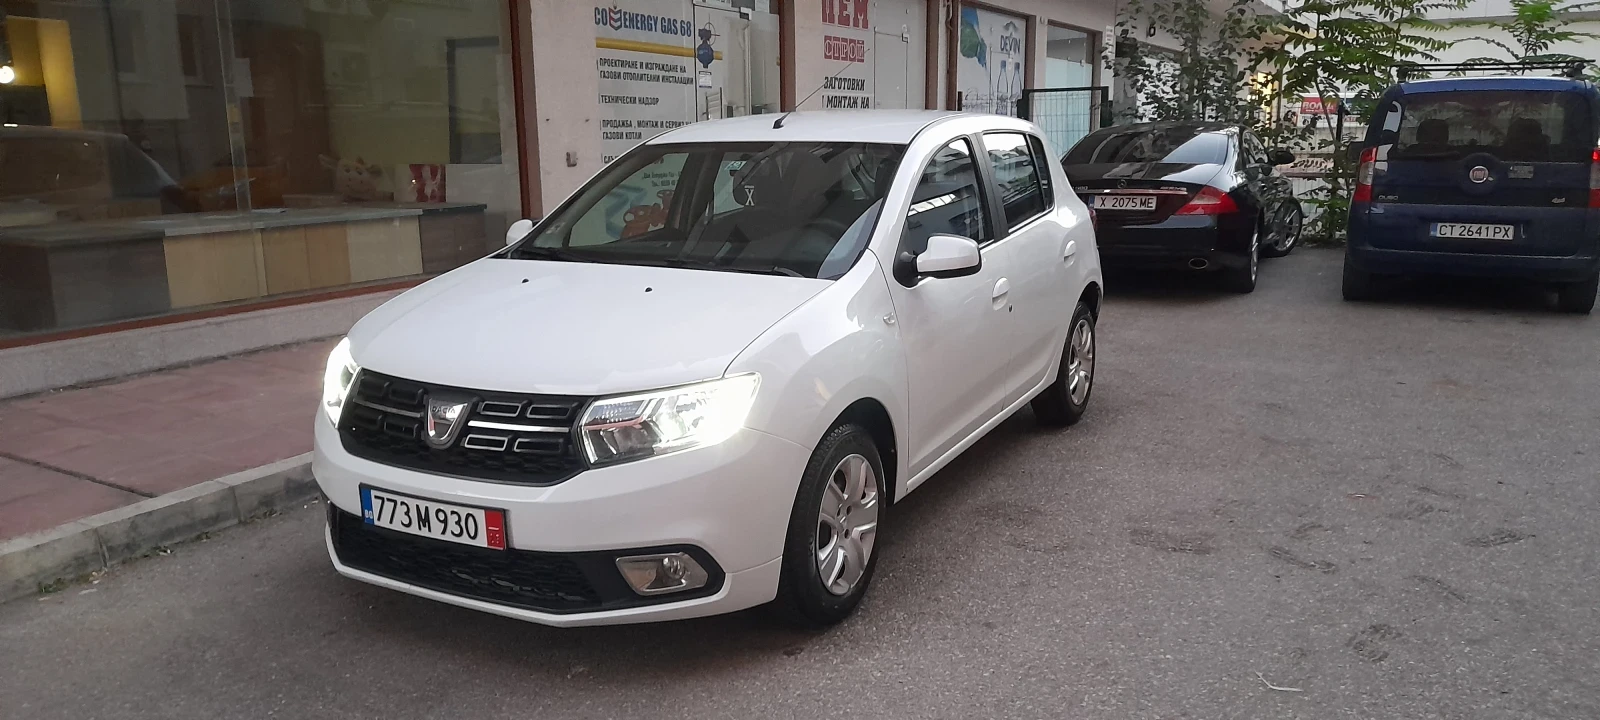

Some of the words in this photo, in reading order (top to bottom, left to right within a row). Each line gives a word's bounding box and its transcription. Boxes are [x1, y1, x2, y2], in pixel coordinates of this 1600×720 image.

[660, 16, 678, 36] GAS
[680, 19, 692, 37] 68
[824, 38, 865, 61] СТРОЙ
[1000, 33, 1021, 54] DEVIN
[599, 57, 638, 70] ПРОЕКТИРАНЕ
[639, 61, 644, 70] И
[645, 62, 679, 73] ИЗГРАЖДАНЕ
[680, 65, 687, 73] НА
[599, 70, 622, 80] ГАЗОВИ
[622, 71, 661, 83] ОТОПЛИТЕЛНИ
[661, 75, 694, 85] ИНСТАЛАЦИИ
[824, 76, 866, 91] ЗАГОТОВКИ
[600, 94, 637, 105] ТЕХНИЧЕСКИ
[638, 96, 660, 106] НАДЗОР
[826, 95, 859, 109] МОНТАЖ
[860, 96, 870, 109] НА
[602, 119, 633, 129] ПРОДАЖБА
[637, 120, 660, 129] МОНТАЖ
[660, 120, 665, 129] И
[602, 131, 624, 140] ГАЗОВИ
[625, 131, 642, 140] КОТЛИ
[1100, 197, 1107, 208] X
[1112, 197, 1138, 208] 2075
[1140, 198, 1154, 209] ME
[1439, 224, 1457, 236] CT
[1458, 225, 1490, 237] 2641
[1492, 226, 1511, 239] PX
[373, 495, 413, 528] 773
[416, 503, 432, 533] M
[435, 508, 479, 541] 930
